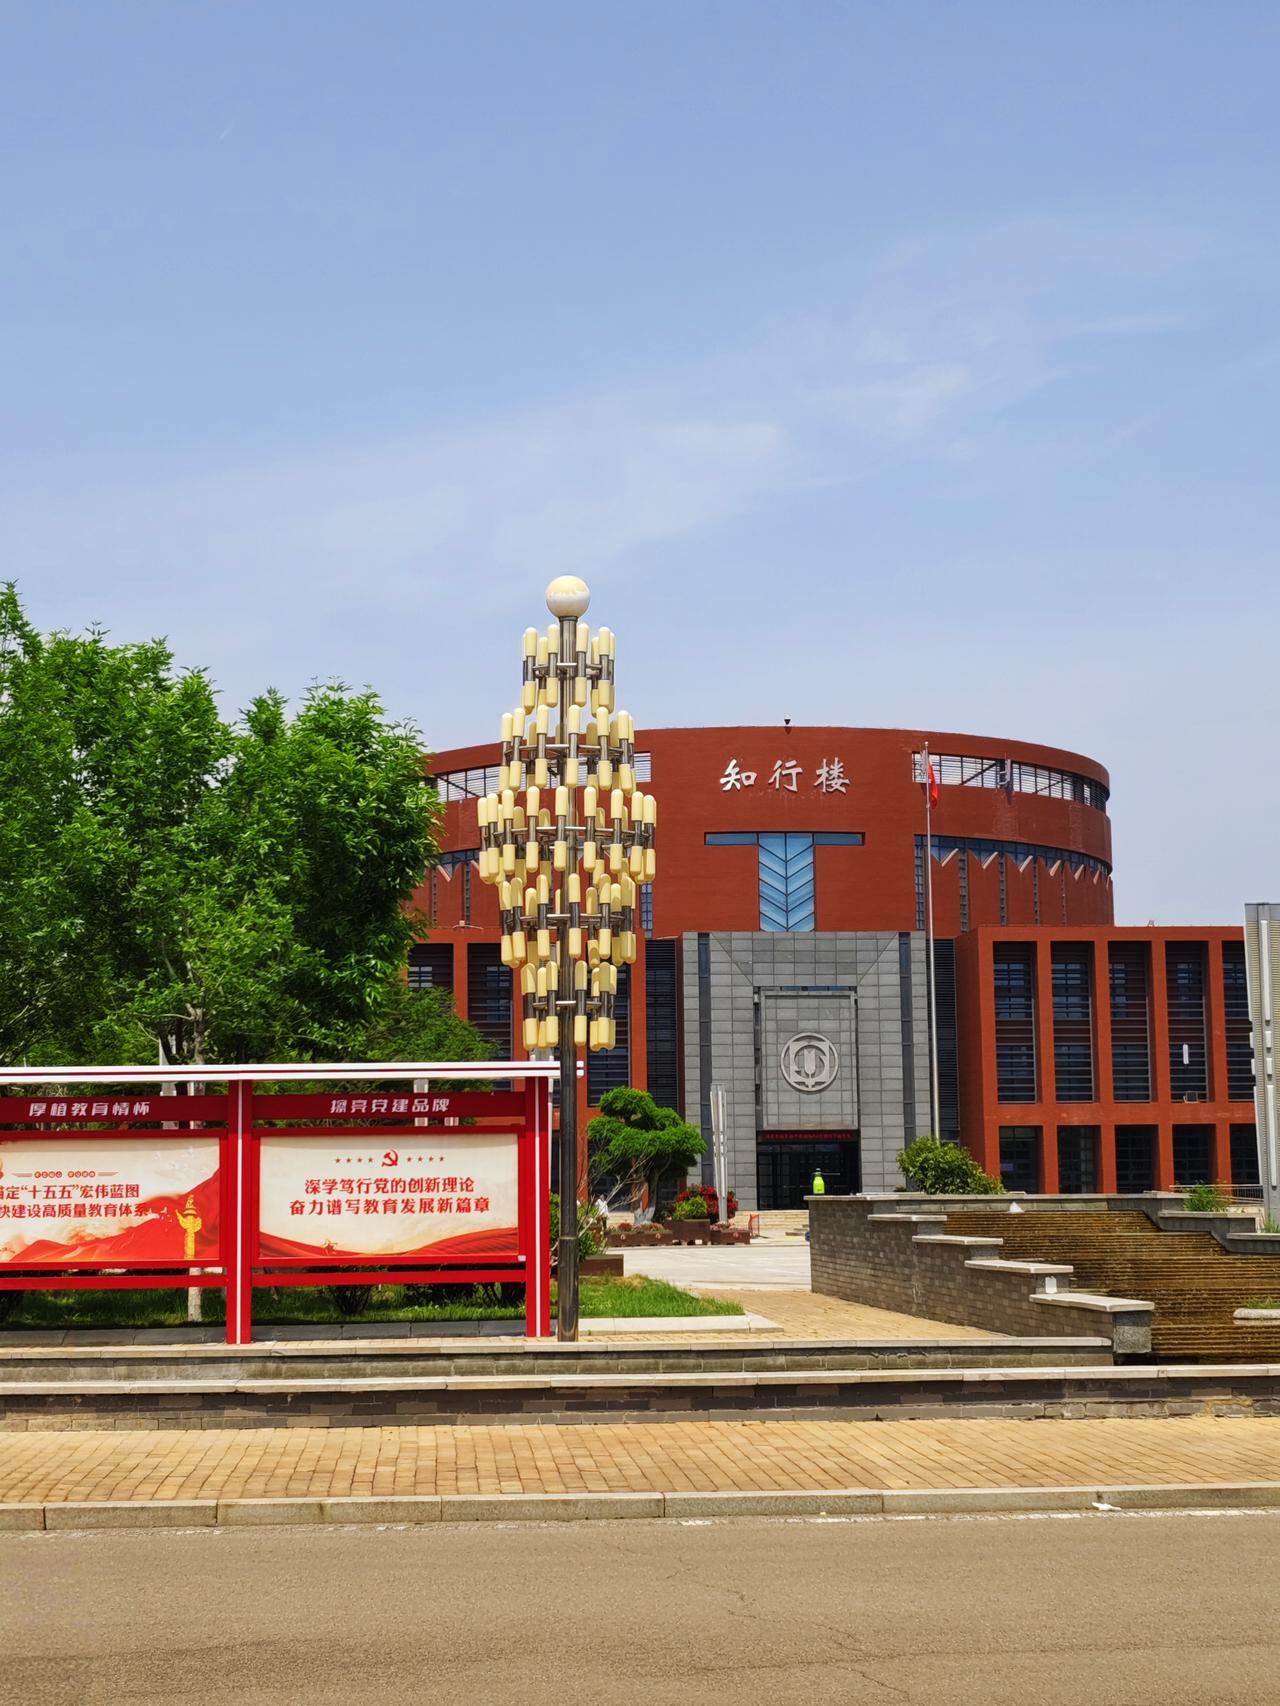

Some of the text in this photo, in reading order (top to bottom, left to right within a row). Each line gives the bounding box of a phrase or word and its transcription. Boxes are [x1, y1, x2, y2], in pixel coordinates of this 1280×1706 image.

[719, 757, 850, 793] 知行楼
[29, 1102, 151, 1117] 厚植教育情怀
[304, 1176, 475, 1195] 深学笃行党的创新理论
[289, 1197, 490, 1216] 奋力谱写教育发展新篇章
